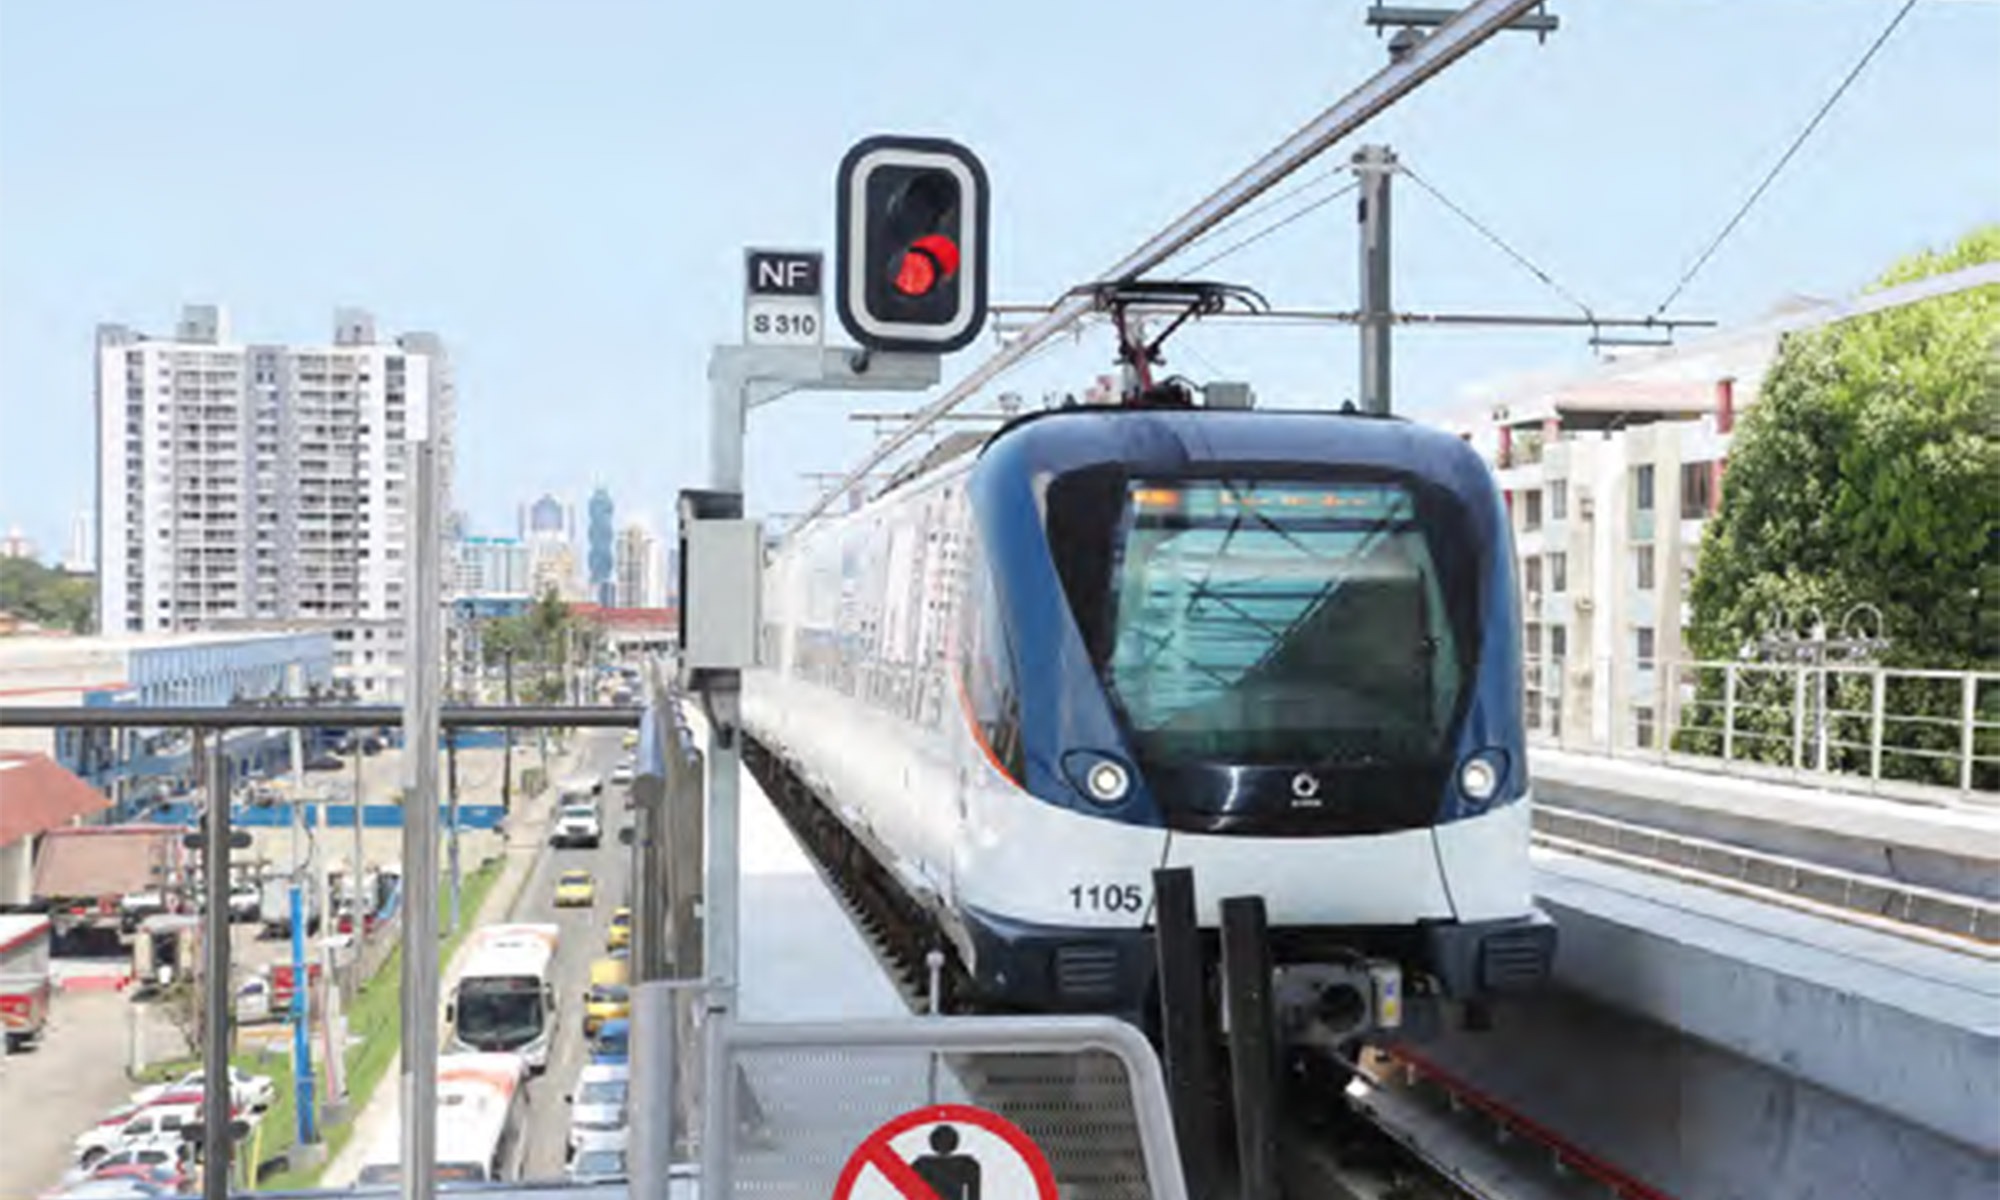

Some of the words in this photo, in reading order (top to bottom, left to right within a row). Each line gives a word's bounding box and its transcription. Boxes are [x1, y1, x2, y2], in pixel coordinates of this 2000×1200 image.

[759, 260, 809, 287] NF
[754, 314, 770, 334] S
[775, 314, 816, 336] 310
[1070, 884, 1143, 913] 1105
